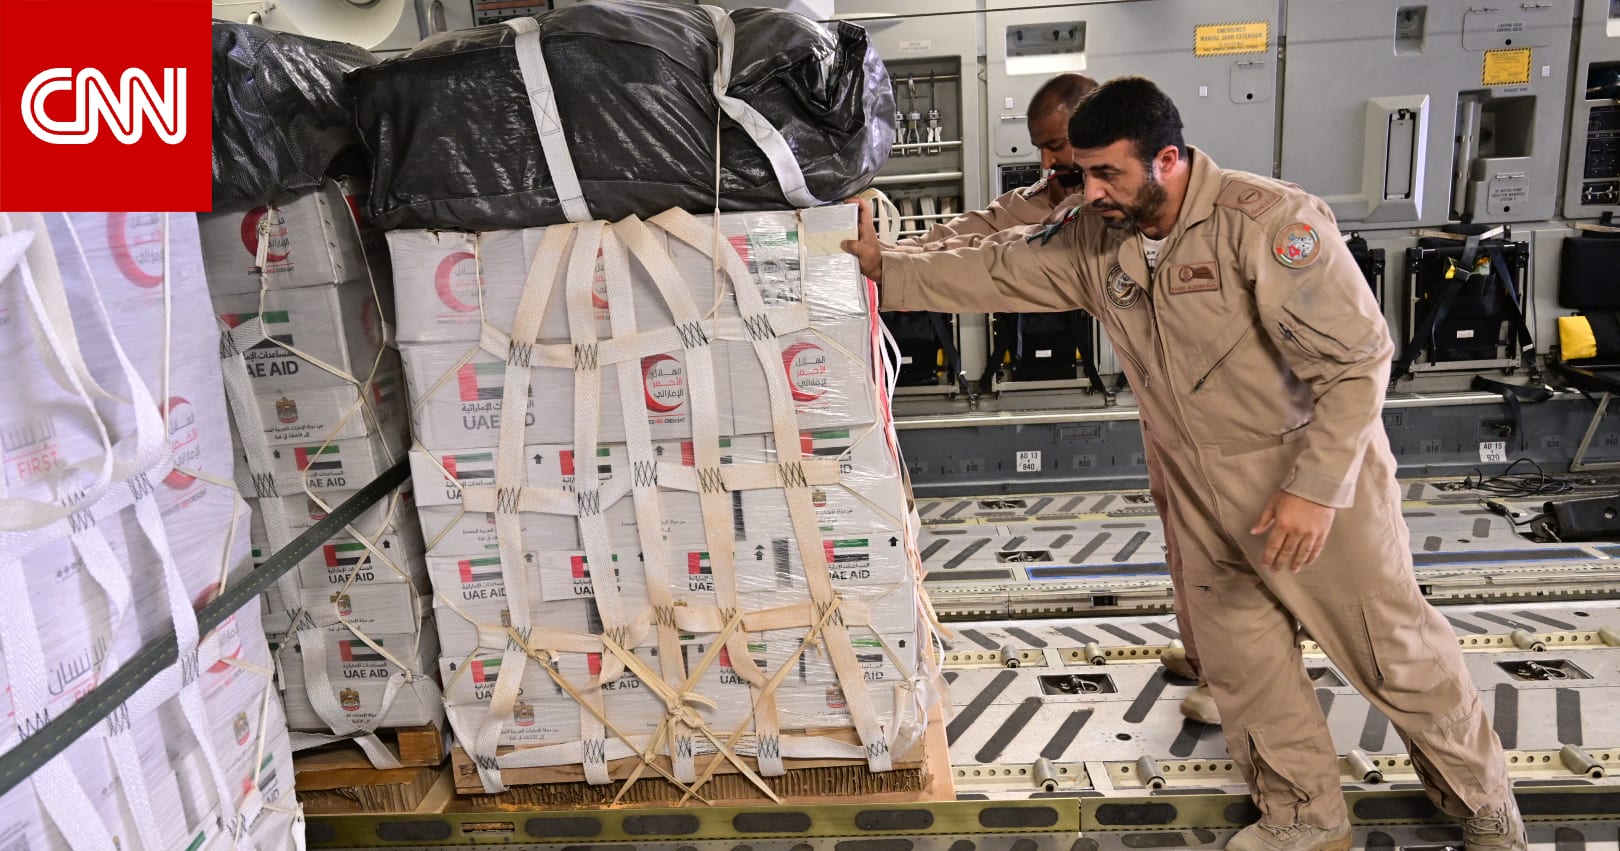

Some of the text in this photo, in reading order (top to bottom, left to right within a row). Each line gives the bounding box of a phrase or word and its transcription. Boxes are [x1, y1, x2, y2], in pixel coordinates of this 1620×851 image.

[247, 360, 299, 379] AE AID
[651, 367, 682, 378] الهلال
[653, 376, 683, 389] الأحمر
[653, 389, 684, 400] الإماراتي
[462, 414, 501, 430] UAE
[1495, 442, 1503, 450] 15
[1486, 453, 1500, 462] 920
[17, 450, 59, 480] FIRST
[1022, 463, 1035, 471] 840
[306, 477, 346, 489] AE AID
[355, 572, 375, 583] AID
[850, 569, 871, 580] AID
[573, 586, 595, 596] UA
[688, 582, 714, 592] UAE
[463, 589, 488, 600] UAE
[343, 668, 389, 679] UAE AID
[863, 670, 885, 681] AID
[601, 679, 640, 691] AE AID
[475, 690, 493, 700] UA
